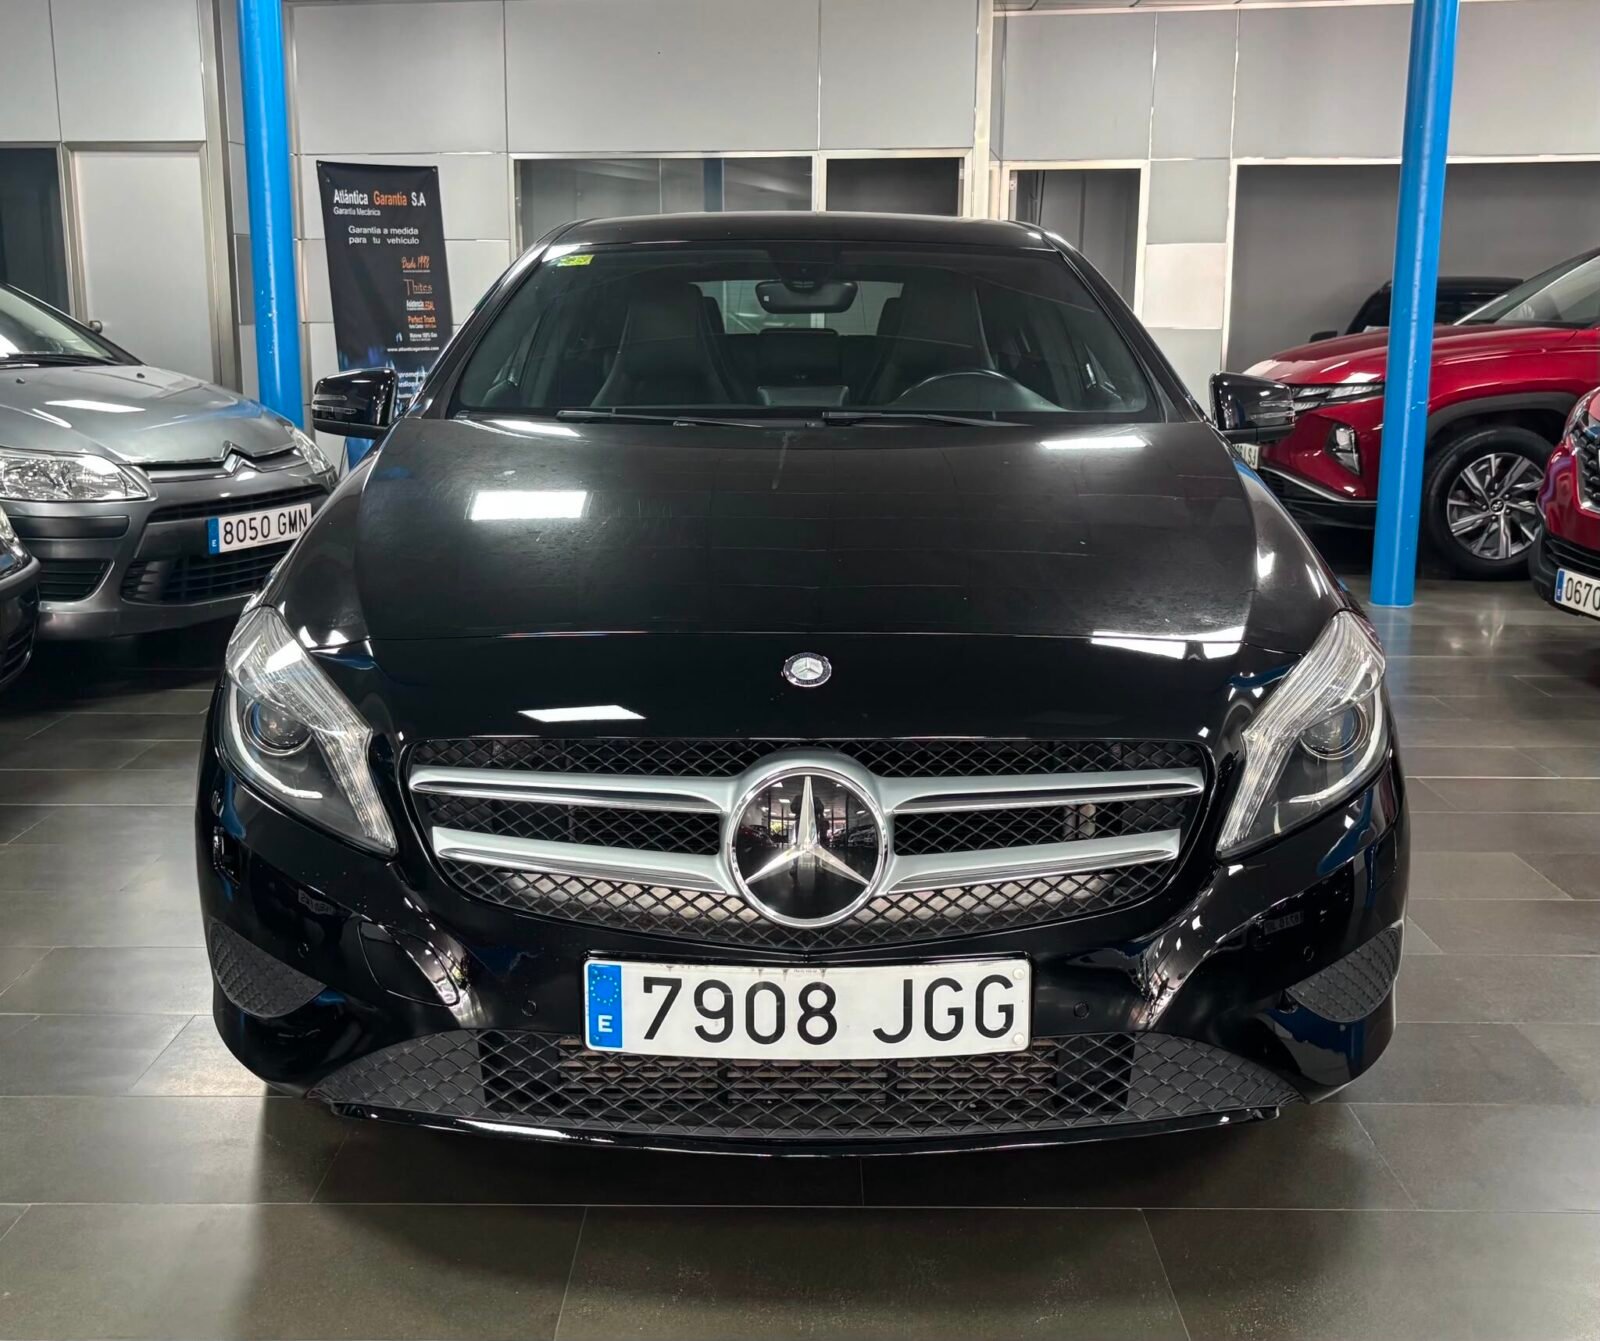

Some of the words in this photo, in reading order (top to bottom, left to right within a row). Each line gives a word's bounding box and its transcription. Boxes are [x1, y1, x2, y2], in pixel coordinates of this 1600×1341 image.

[390, 226, 419, 235] medida
[348, 236, 367, 245] para
[372, 236, 381, 244] tu
[224, 515, 270, 545] 8050
[278, 507, 308, 535] GMN
[643, 976, 837, 1045] 7908
[872, 974, 1015, 1044] JGG
[598, 1014, 613, 1033] E
